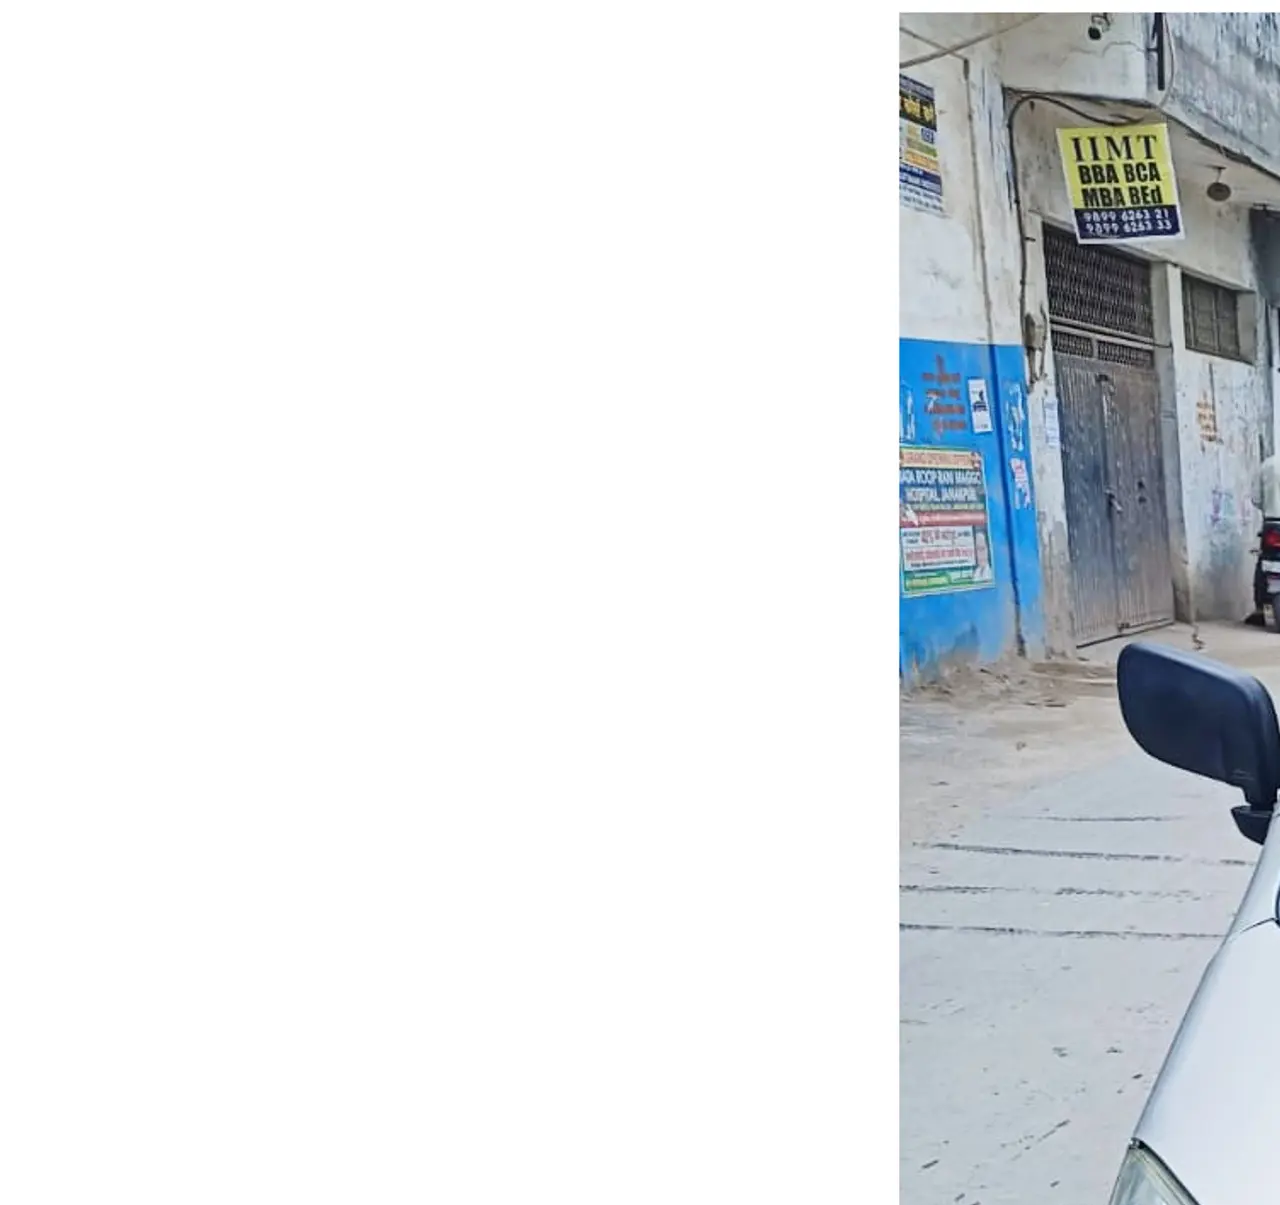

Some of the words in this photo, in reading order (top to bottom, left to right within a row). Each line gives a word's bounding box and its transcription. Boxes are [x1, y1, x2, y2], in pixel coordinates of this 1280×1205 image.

[1070, 134, 1158, 162] IIMT
[1078, 163, 1120, 185] BBA
[1123, 161, 1162, 183] BCA
[1081, 187, 1127, 208] MBA
[1128, 185, 1164, 206] BEd
